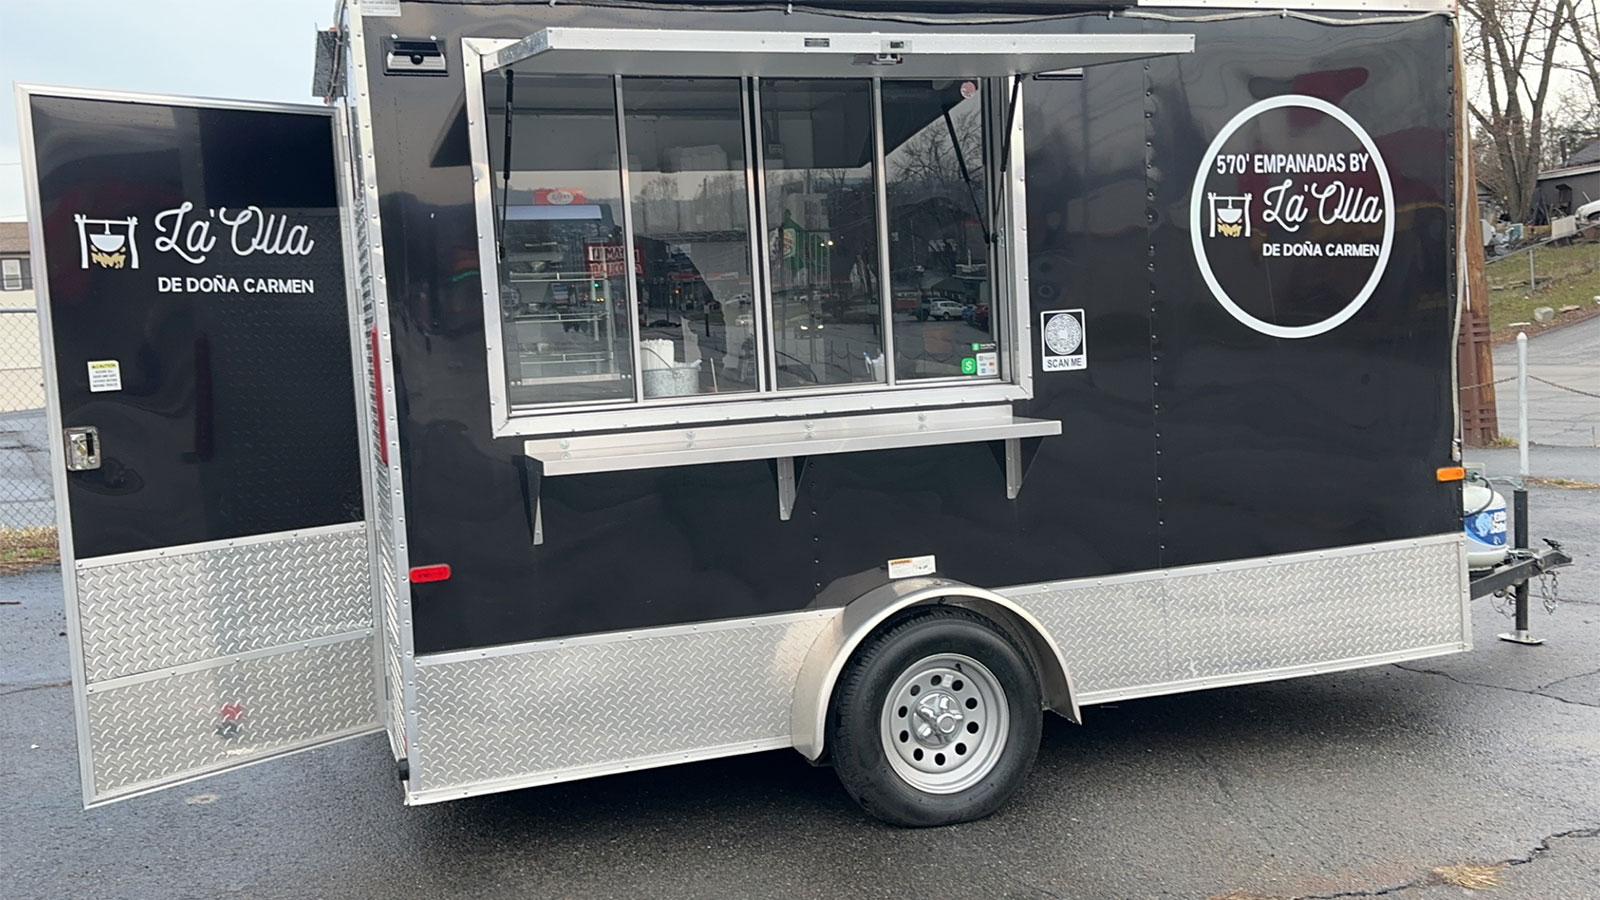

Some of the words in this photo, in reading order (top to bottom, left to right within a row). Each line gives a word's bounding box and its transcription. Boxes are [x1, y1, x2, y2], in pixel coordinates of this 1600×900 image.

[1254, 153, 1346, 173] EMPANADAS
[1349, 153, 1370, 172] BY
[1262, 243, 1281, 256] DE
[1283, 241, 1323, 257] DOÑA
[1325, 243, 1380, 257] CARMEN
[158, 276, 182, 292] DE
[186, 274, 240, 293] DOÑA
[243, 277, 315, 294] CARMEN
[1047, 358, 1069, 369] SCAN
[1070, 357, 1082, 367] ME
